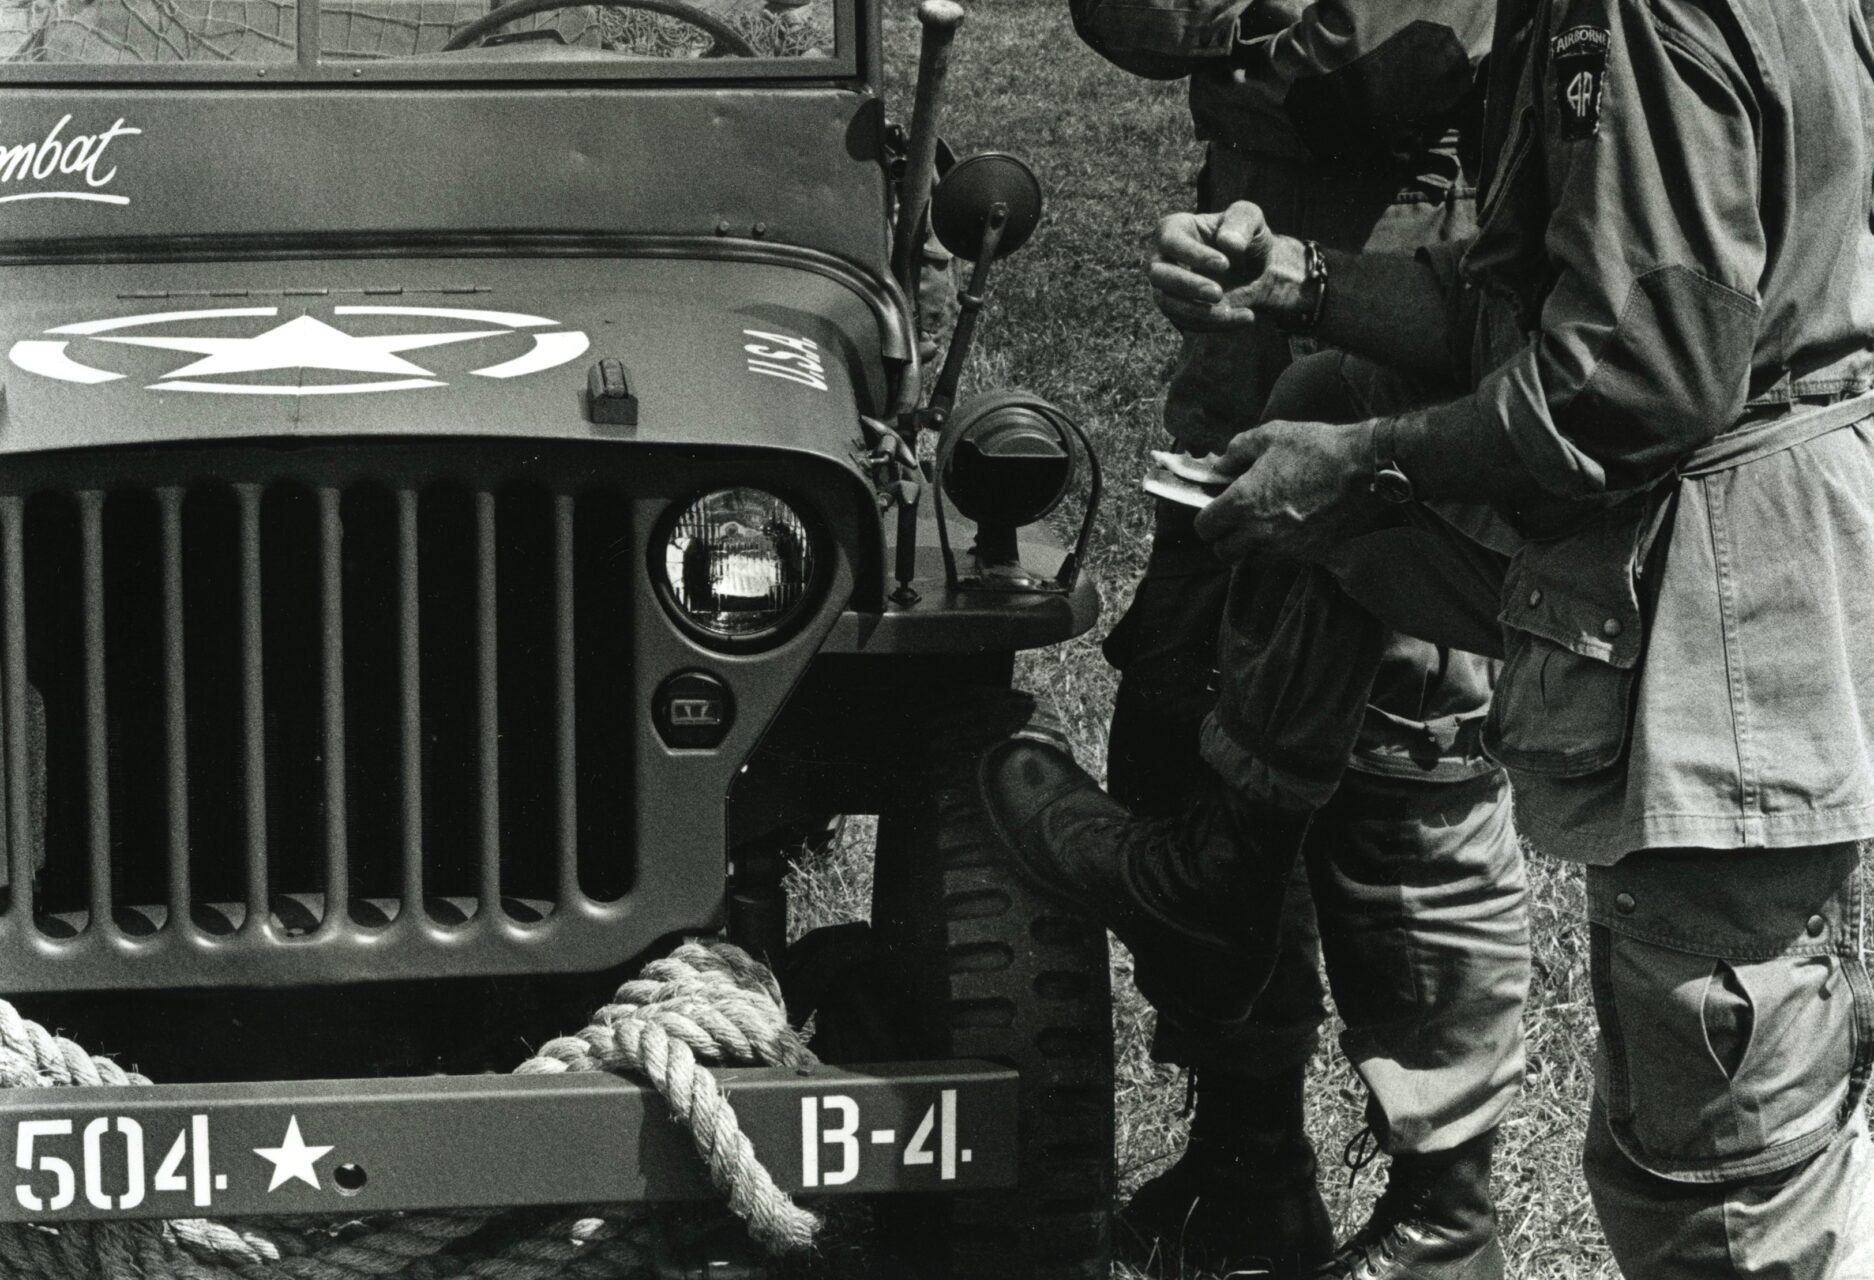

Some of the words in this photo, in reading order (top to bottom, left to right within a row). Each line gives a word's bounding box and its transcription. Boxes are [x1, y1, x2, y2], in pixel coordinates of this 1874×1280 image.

[1556, 29, 1607, 53] AIRBORNE
[15, 1114, 227, 1211] 504.
[801, 1089, 973, 1187] B-4.
